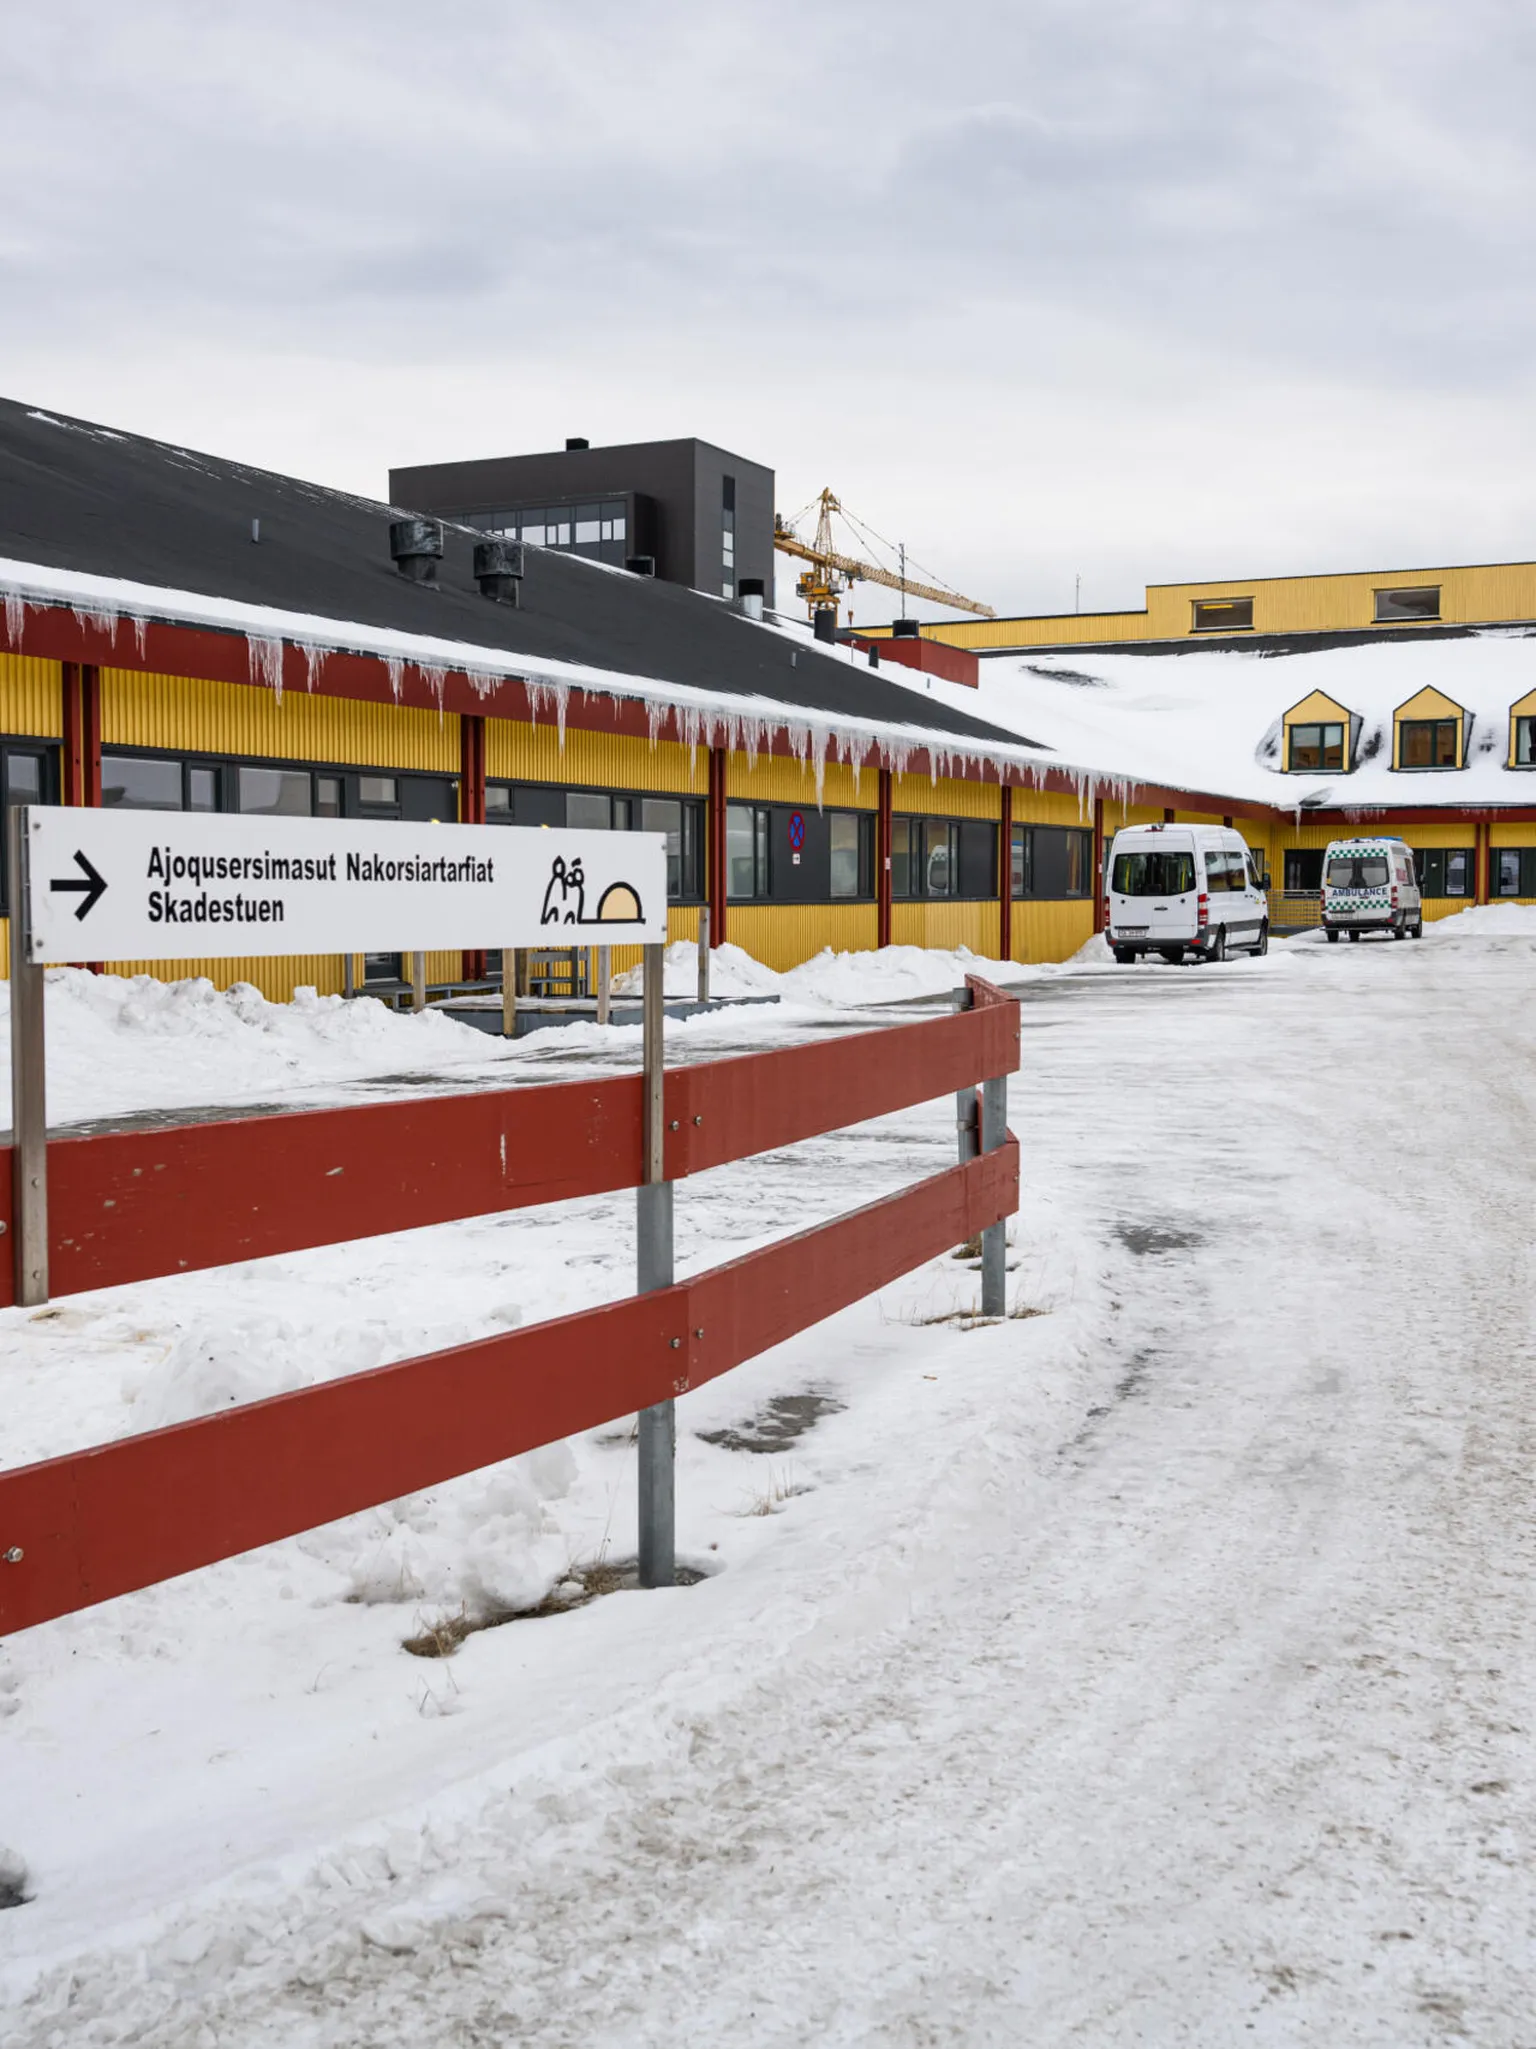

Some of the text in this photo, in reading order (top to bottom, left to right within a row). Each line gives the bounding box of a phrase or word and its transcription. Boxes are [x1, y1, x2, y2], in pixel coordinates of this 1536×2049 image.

[147, 846, 494, 886] Ajoqusersimasut Nakorsiartarfiat
[148, 890, 284, 923] Skadestuen
[1332, 887, 1387, 896] AMBULANCE
